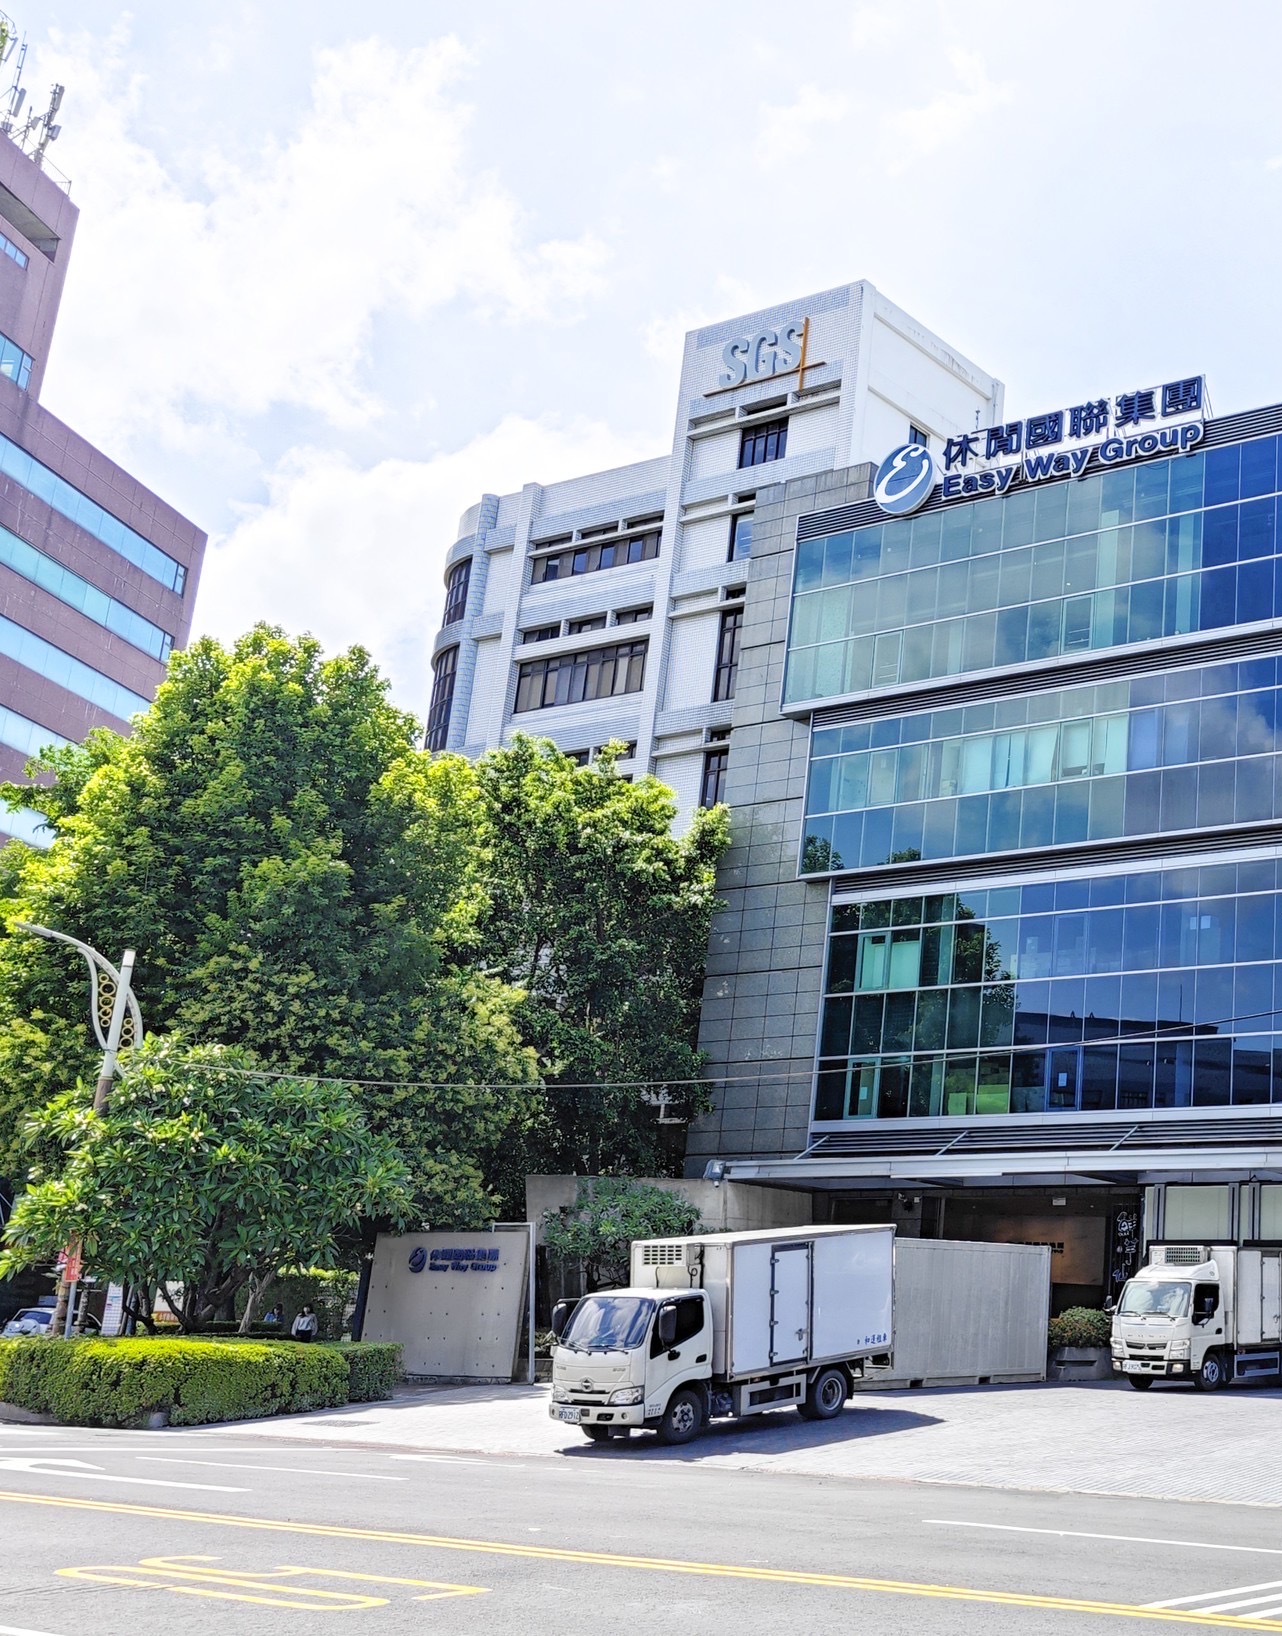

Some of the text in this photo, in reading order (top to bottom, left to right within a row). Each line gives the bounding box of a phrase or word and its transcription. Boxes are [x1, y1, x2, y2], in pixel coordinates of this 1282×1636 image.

[719, 321, 804, 389] SGS
[943, 376, 1201, 470] 休閒國聯集團
[943, 423, 1201, 498] Easy Way Group
